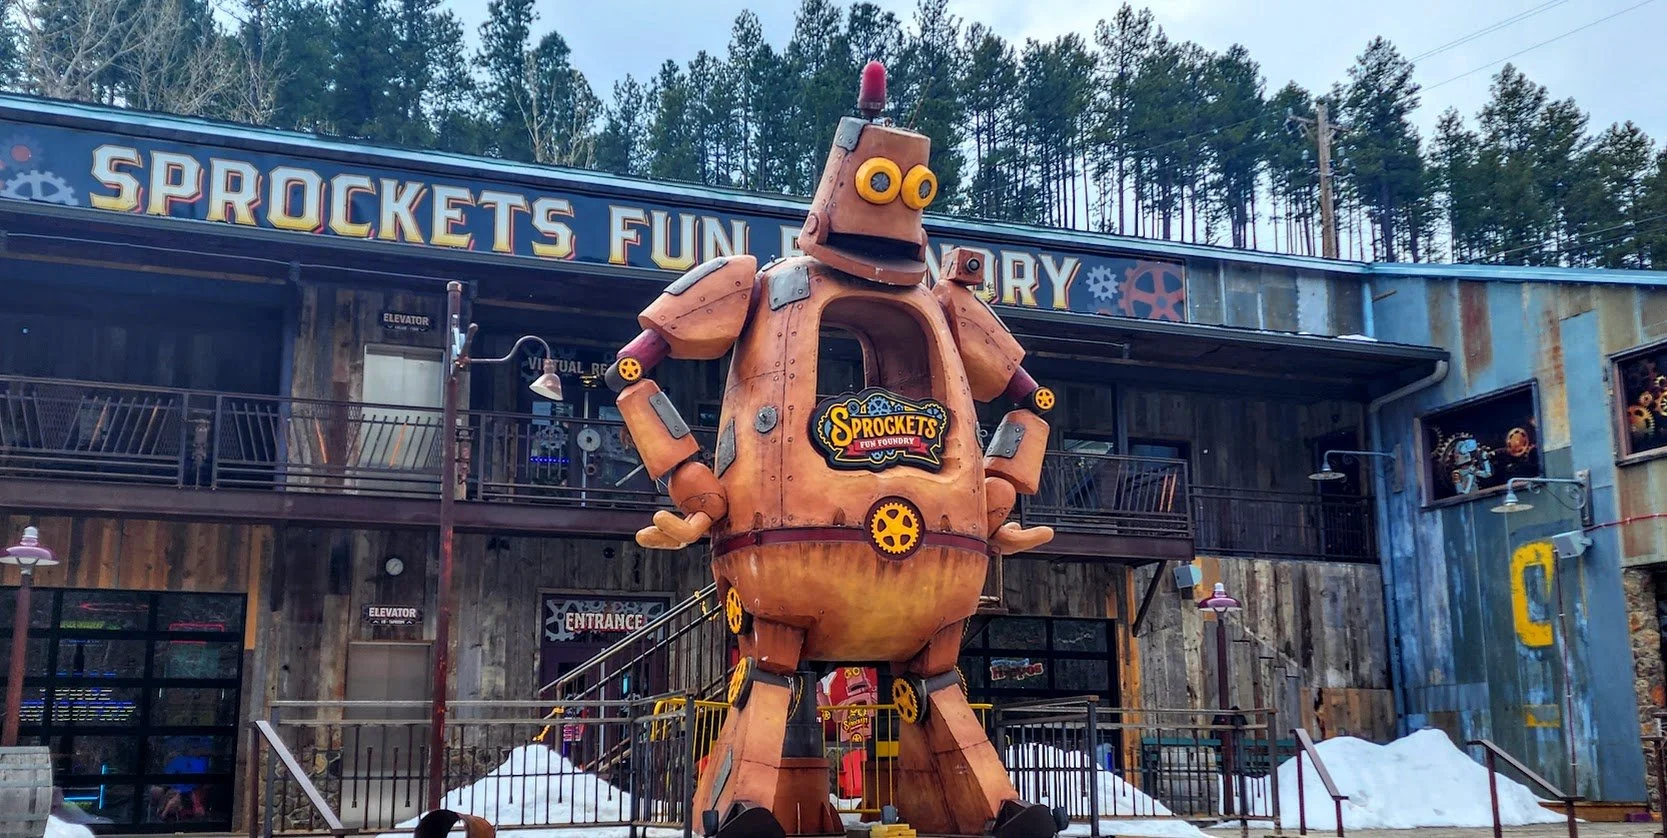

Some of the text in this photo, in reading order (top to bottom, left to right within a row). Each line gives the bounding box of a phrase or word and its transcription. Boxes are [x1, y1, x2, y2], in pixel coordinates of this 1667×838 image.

[90, 144, 576, 260] SPROCKETS
[608, 205, 750, 271] FUN
[383, 312, 429, 326] ELEVATOR
[528, 357, 584, 374] VITUAL
[830, 406, 938, 447] SPROCKETS
[860, 437, 915, 449] FUN FOUNDRY
[368, 607, 416, 618] ELEVATOR
[565, 612, 643, 632] ENTRANCE
